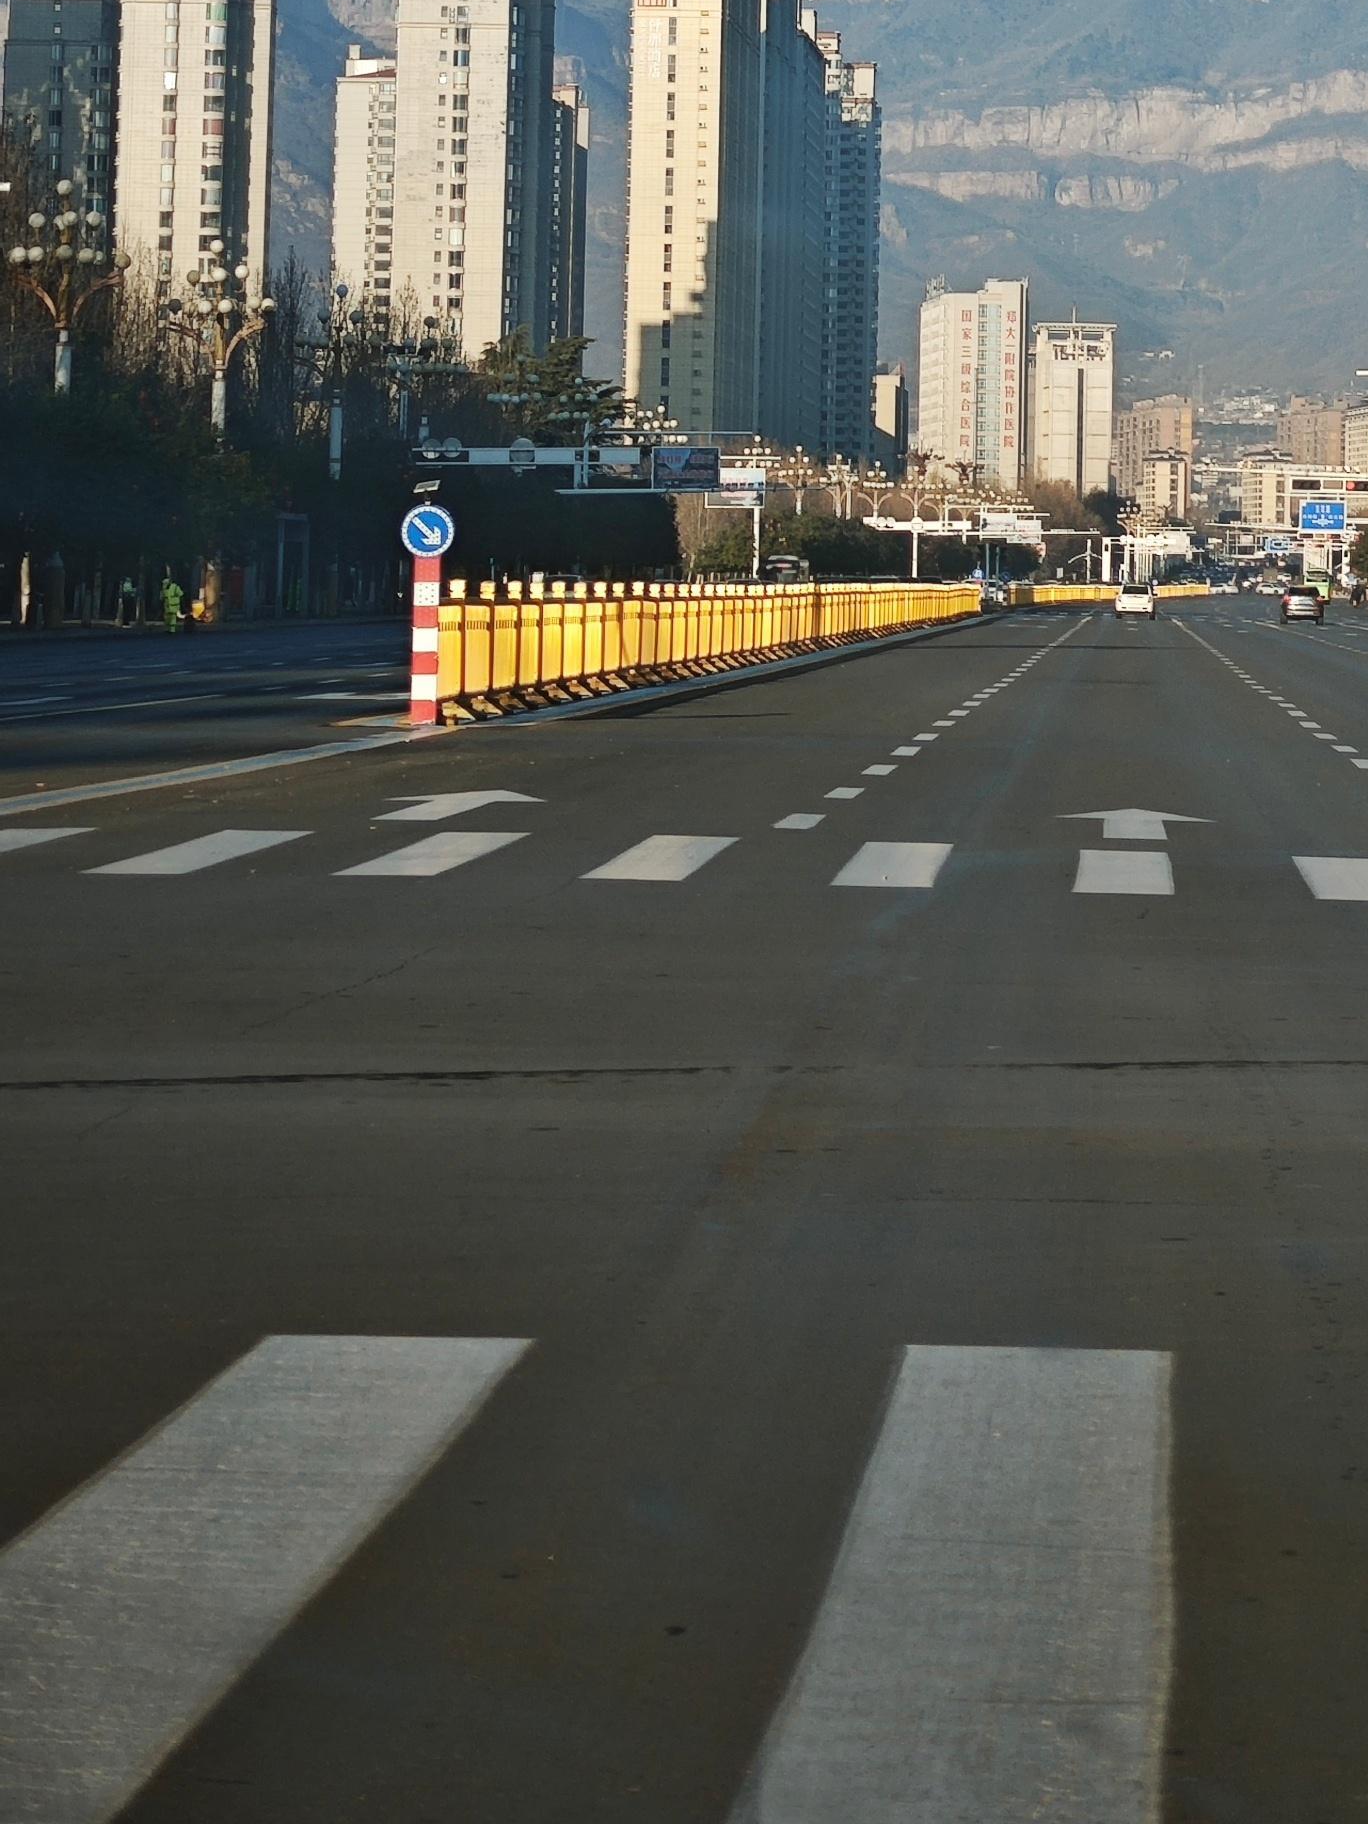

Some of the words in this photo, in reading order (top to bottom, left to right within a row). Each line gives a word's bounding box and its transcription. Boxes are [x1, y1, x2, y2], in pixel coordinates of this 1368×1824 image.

[960, 310, 972, 447] 国家三级综合医院
